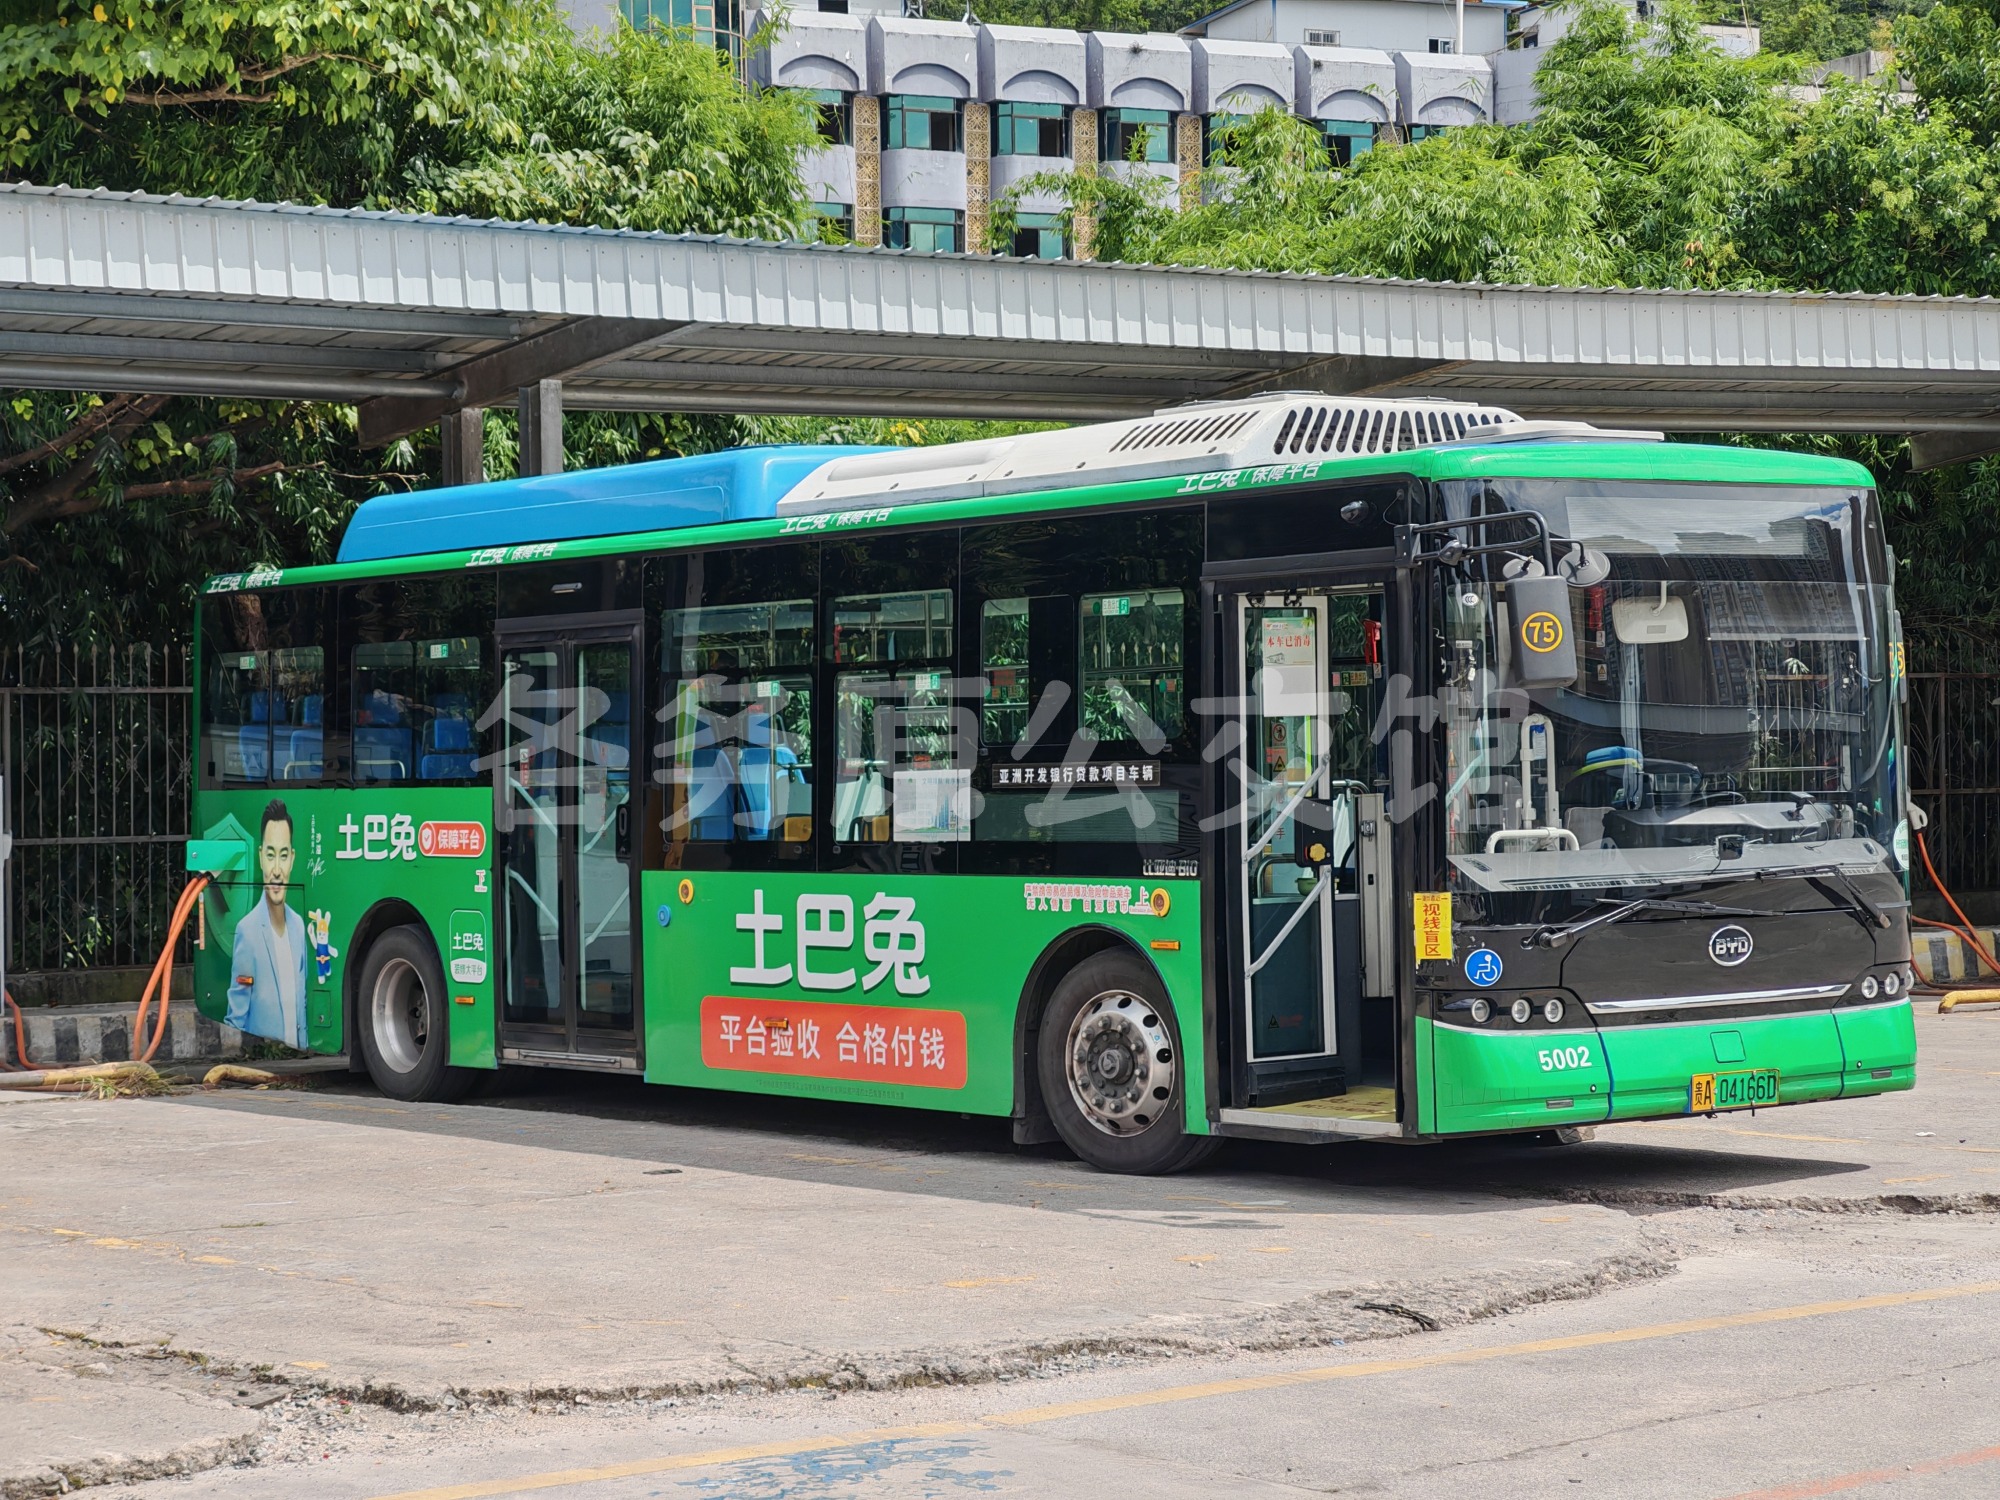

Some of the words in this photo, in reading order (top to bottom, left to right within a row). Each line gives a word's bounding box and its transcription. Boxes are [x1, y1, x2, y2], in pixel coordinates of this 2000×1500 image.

[1267, 635, 1311, 647] 本车已消毒
[1529, 621, 1556, 643] 75
[998, 764, 1154, 783] 亚洲开发银行贷款项目车辆
[336, 813, 417, 860] 土巴兔
[437, 829, 480, 850] 保障平台
[1027, 898, 1072, 911] 无人售票
[1084, 899, 1129, 913] 自觉投币
[1136, 888, 1149, 906] 上
[1423, 903, 1441, 956] 视线盲区
[452, 932, 484, 951] 土巴兔
[729, 889, 931, 994] 土巴兔
[1715, 936, 1748, 955] BYD
[454, 963, 483, 976] 装修大平台
[719, 1014, 820, 1060] 平台验收
[835, 1021, 945, 1070] 合格付钱
[1538, 1045, 1592, 1072] 5002
